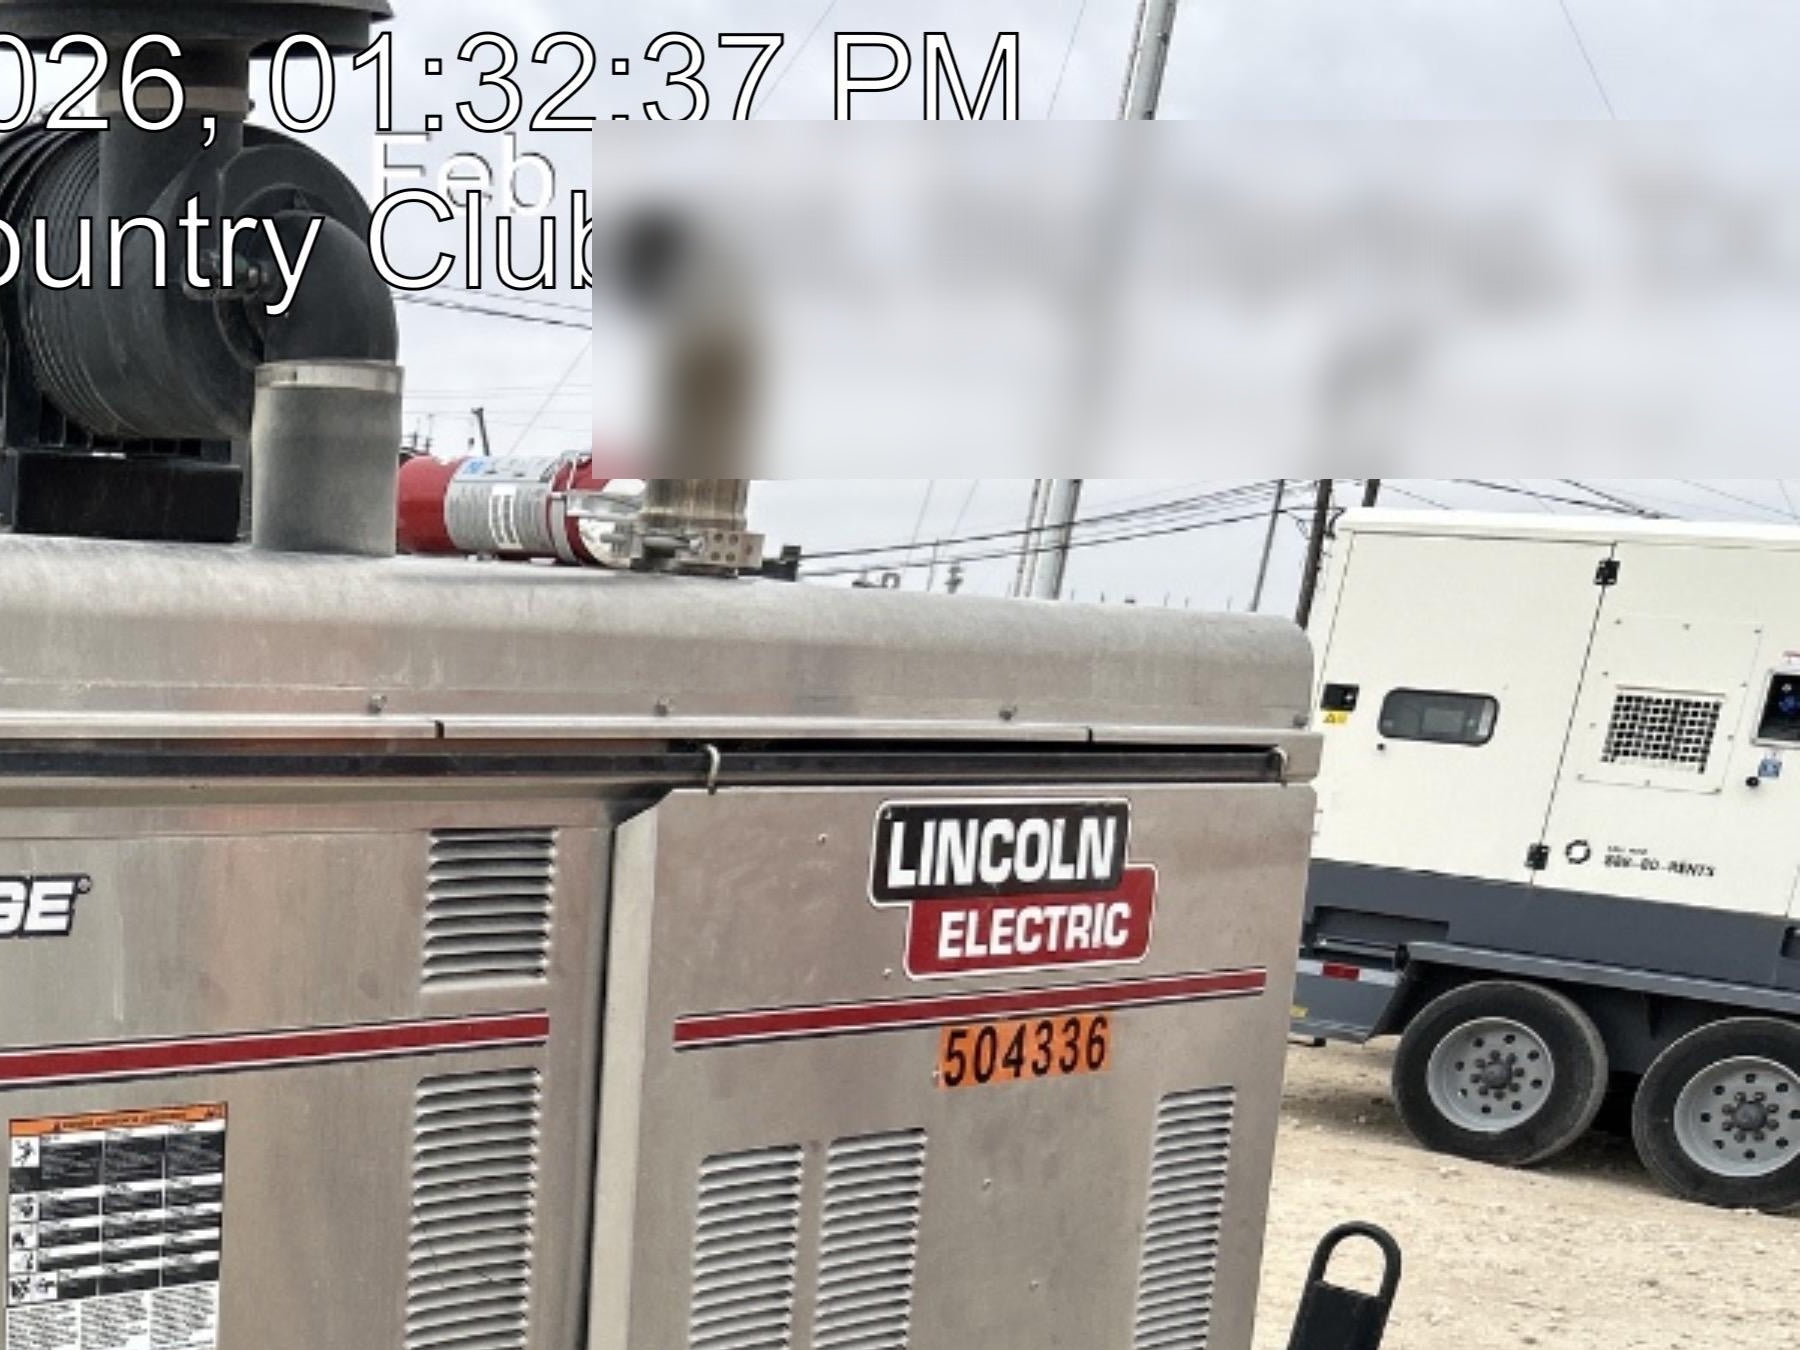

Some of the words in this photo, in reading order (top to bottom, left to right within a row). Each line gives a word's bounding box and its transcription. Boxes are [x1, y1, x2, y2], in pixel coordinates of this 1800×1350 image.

[886, 815, 1117, 889] LINCOLN
[937, 901, 1132, 960] ELECTRIC
[943, 1016, 1109, 1088] 504336
